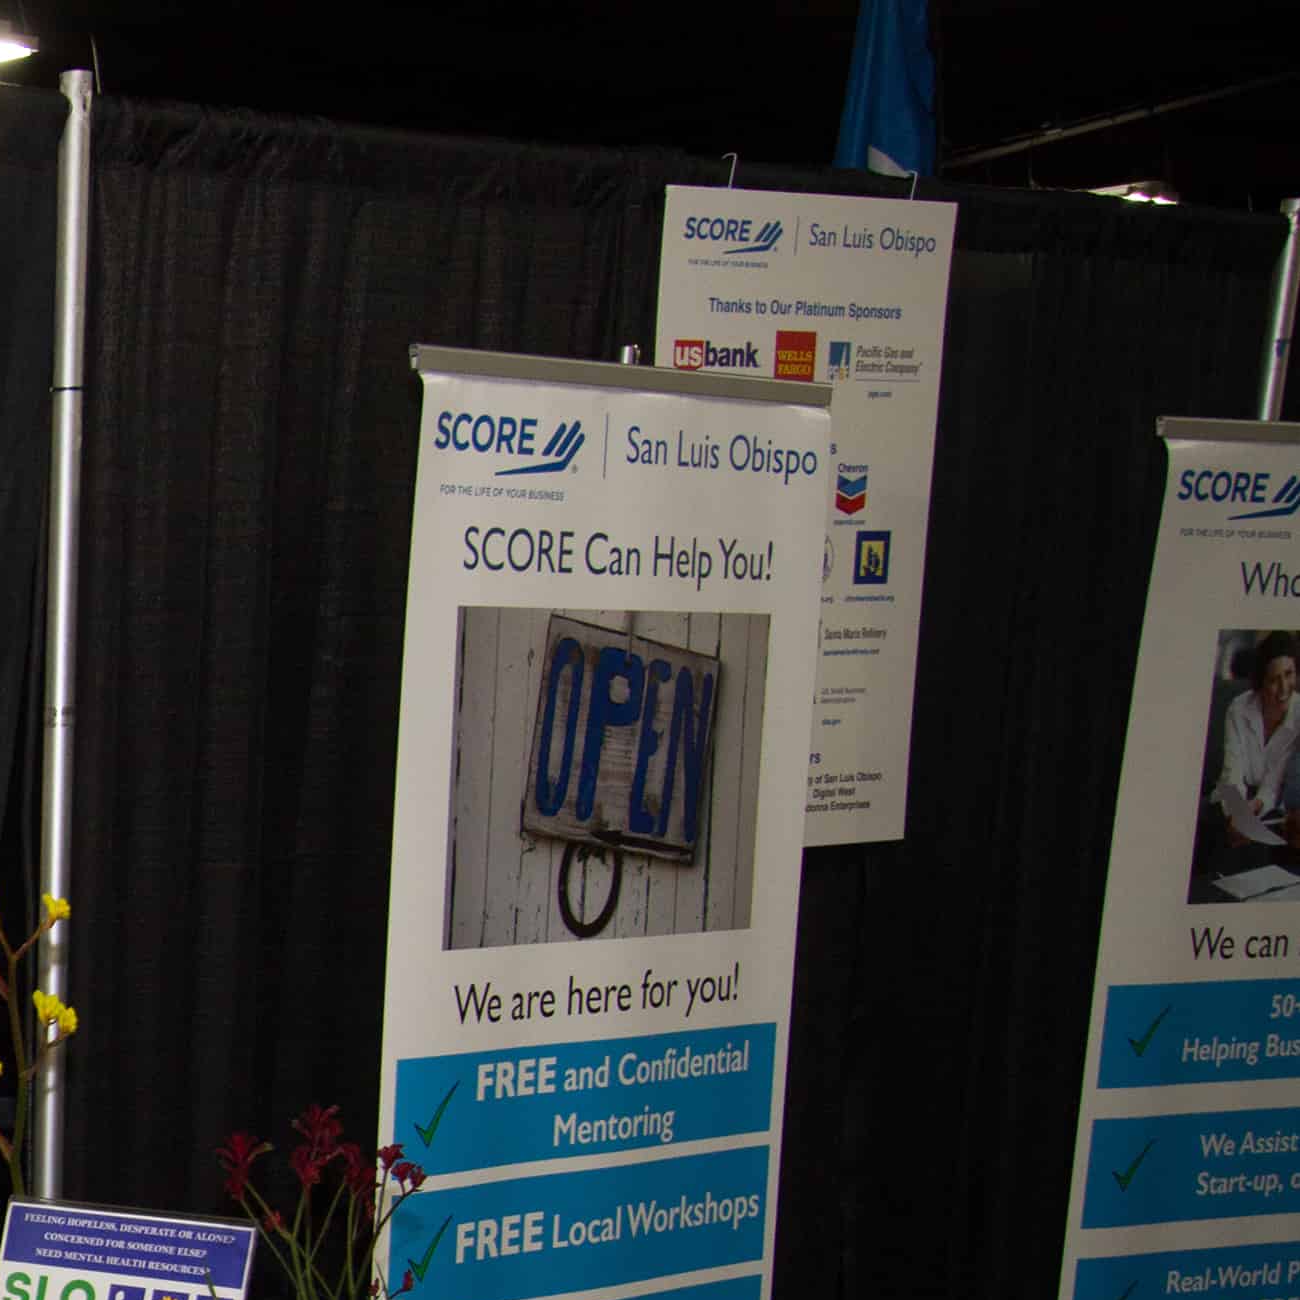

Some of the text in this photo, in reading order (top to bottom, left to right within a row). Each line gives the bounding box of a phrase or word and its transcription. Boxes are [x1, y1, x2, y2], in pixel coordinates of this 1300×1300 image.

[684, 217, 751, 242] SCORE
[809, 223, 937, 257] San Luis Obispo
[709, 297, 902, 321] Thanks to Our Platinum Sponsors
[777, 350, 813, 363] WELLS
[777, 363, 812, 377] FARGO
[435, 410, 538, 456] SCORE
[626, 425, 818, 486] San Luis Obispo
[440, 484, 565, 503] FOR THE LIFE OF YOUR BUSINESS
[1177, 468, 1270, 503] SCORE
[463, 525, 774, 593] SCORE Can Help You!
[536, 637, 715, 844] OPEN
[1191, 926, 1289, 960] We can
[454, 961, 740, 1025] We are here for you!
[1181, 1035, 1260, 1069] Helping
[476, 1039, 751, 1102] FREE and Confidential
[553, 1105, 676, 1149] Mentoring
[1201, 1130, 1300, 1159] We Assist
[1195, 1170, 1284, 1197] Start-up,
[24, 1212, 236, 1245] FEELING HOPELESS, DESPERATE OR ALONE?
[455, 1190, 761, 1265] FREE Local Workshops
[35, 1247, 62, 1260] NEED
[63, 1250, 106, 1265] MENTAL
[106, 1255, 147, 1270] HEALTH
[43, 1231, 207, 1259] CONCERNED FOR SOMEONE ELSE?
[1165, 1261, 1281, 1294] Real-World
